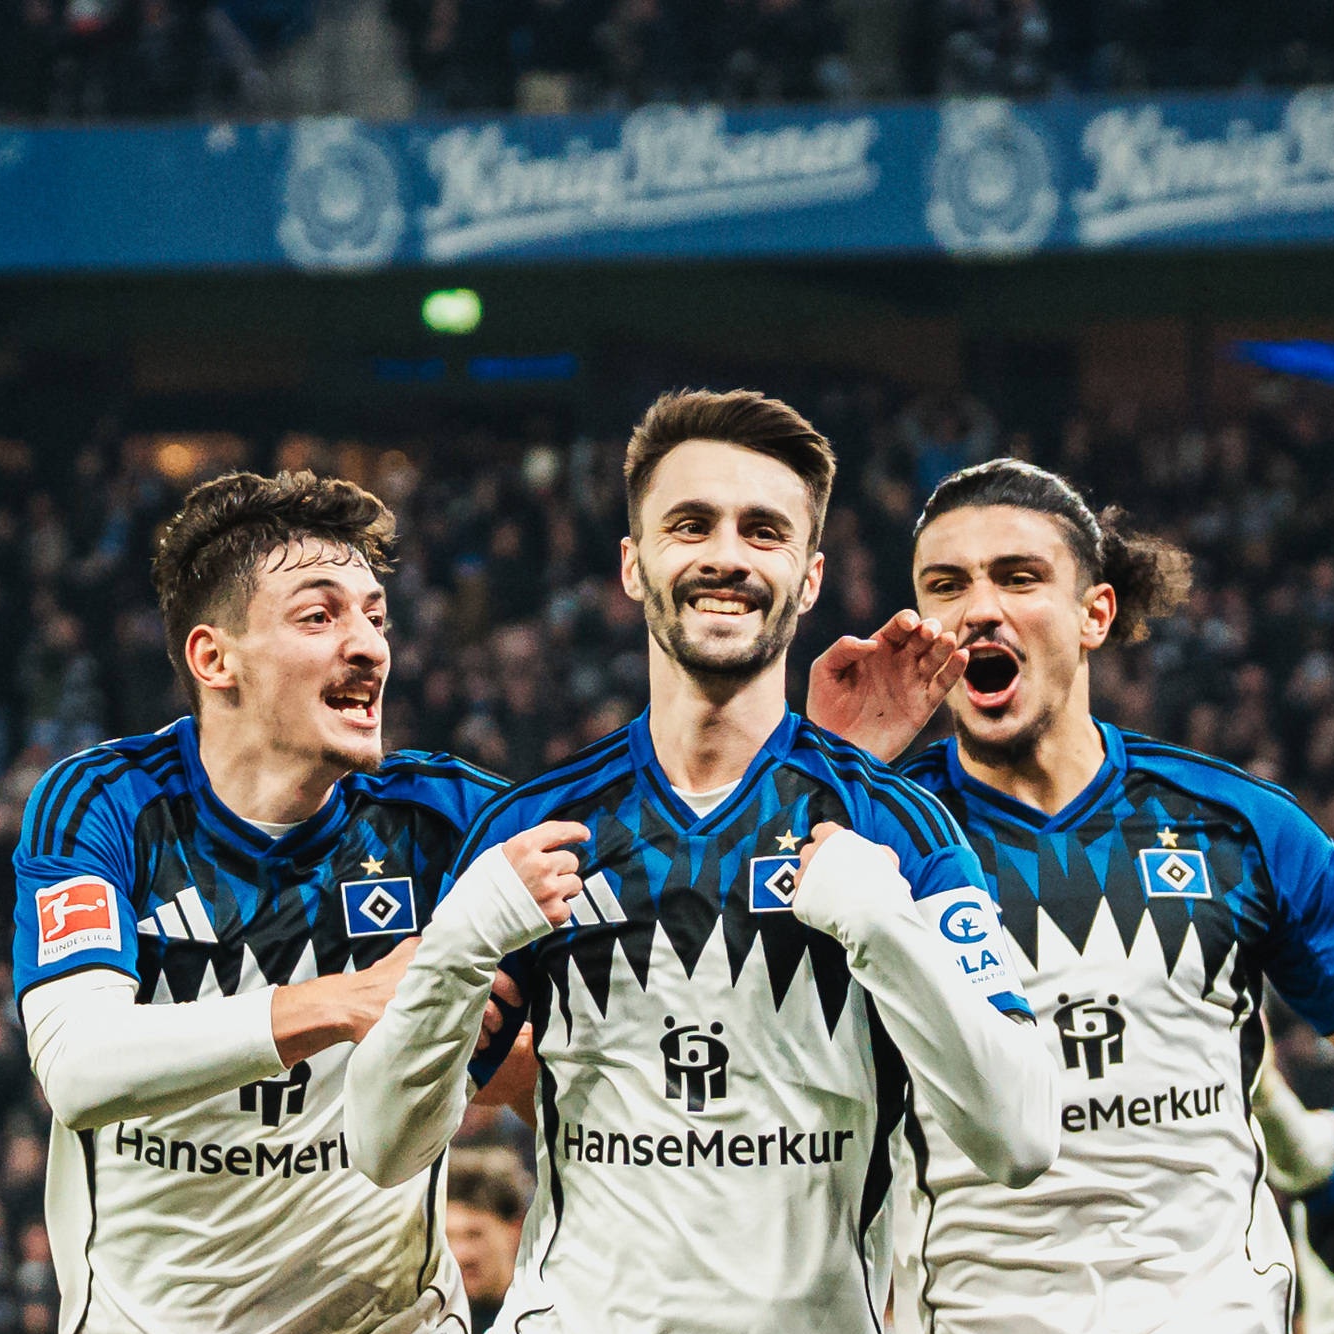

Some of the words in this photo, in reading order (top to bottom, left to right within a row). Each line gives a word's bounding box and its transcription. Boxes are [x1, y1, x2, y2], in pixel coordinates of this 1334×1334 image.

[956, 949, 1004, 975] LA
[1061, 1083, 1225, 1133] eMerkur
[116, 1121, 350, 1178] HanseMer
[564, 1122, 854, 1168] HanseMerkur
